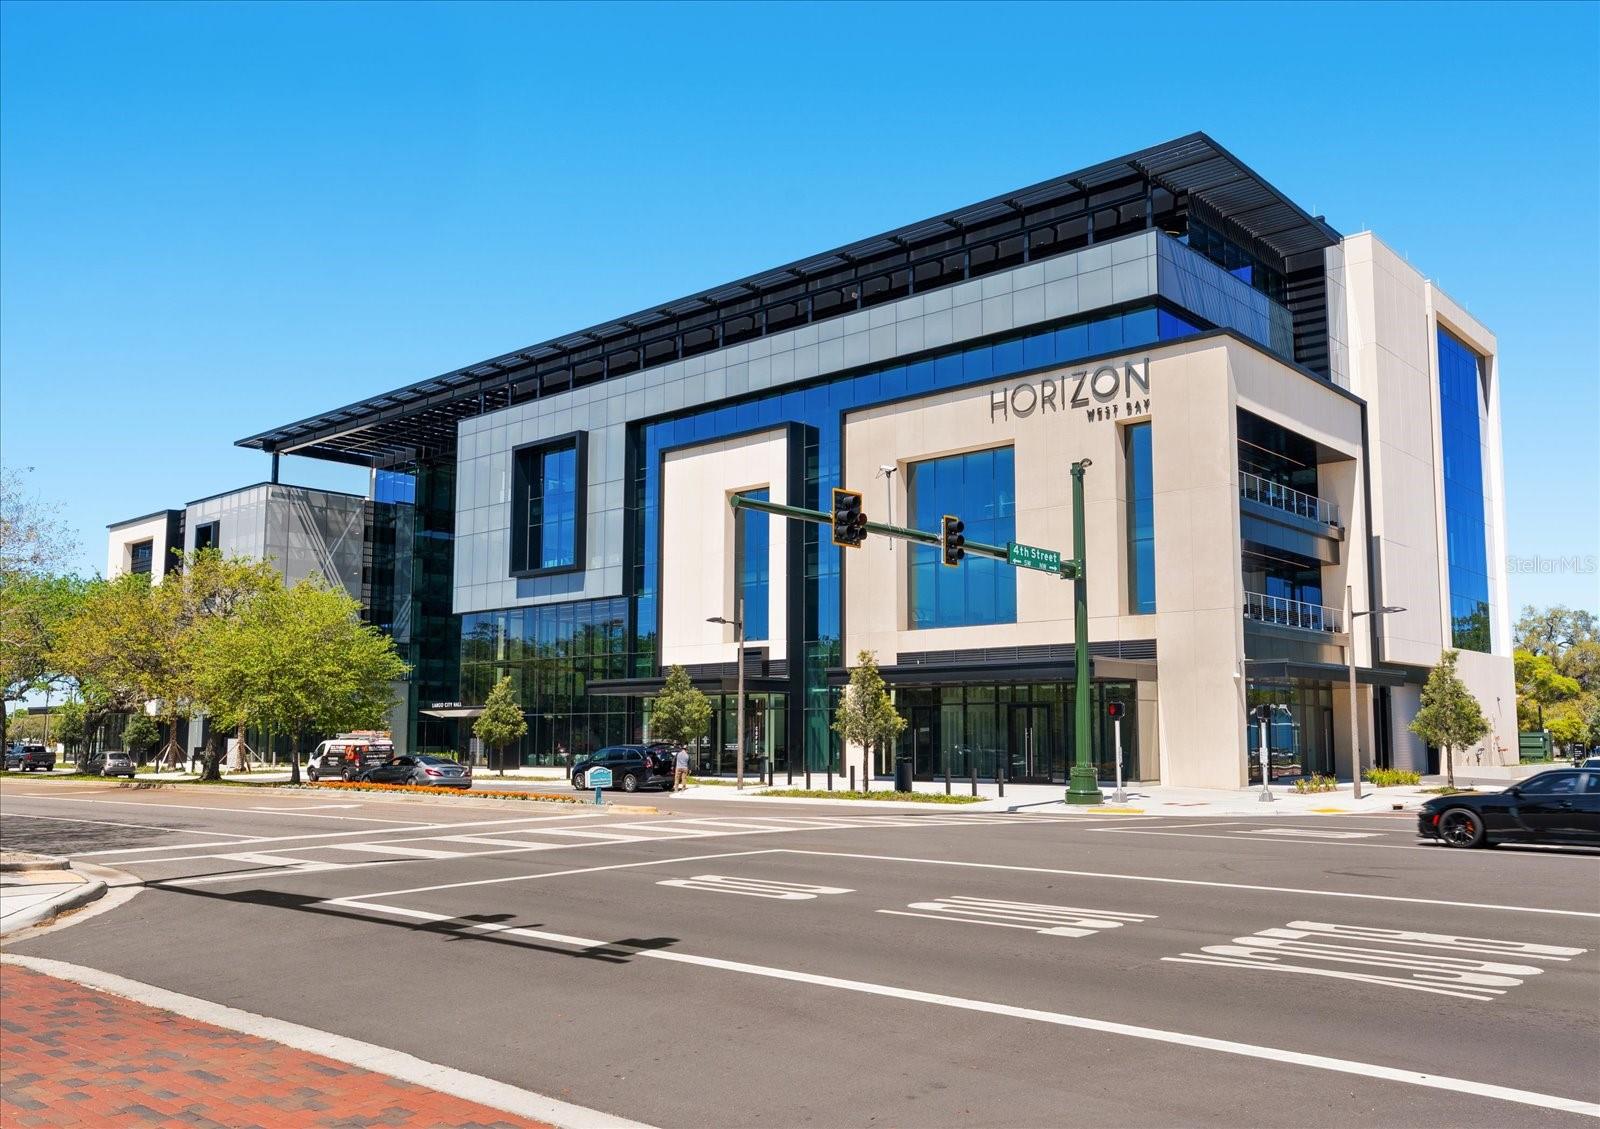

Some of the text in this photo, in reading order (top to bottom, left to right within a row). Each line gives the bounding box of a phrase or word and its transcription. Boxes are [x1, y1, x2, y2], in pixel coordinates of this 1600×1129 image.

[991, 357, 1150, 423] HORIZON
[1087, 399, 1150, 421] WEST BAY
[1013, 545, 1057, 562] 4th Street
[1160, 919, 1588, 1001] BLOCK
